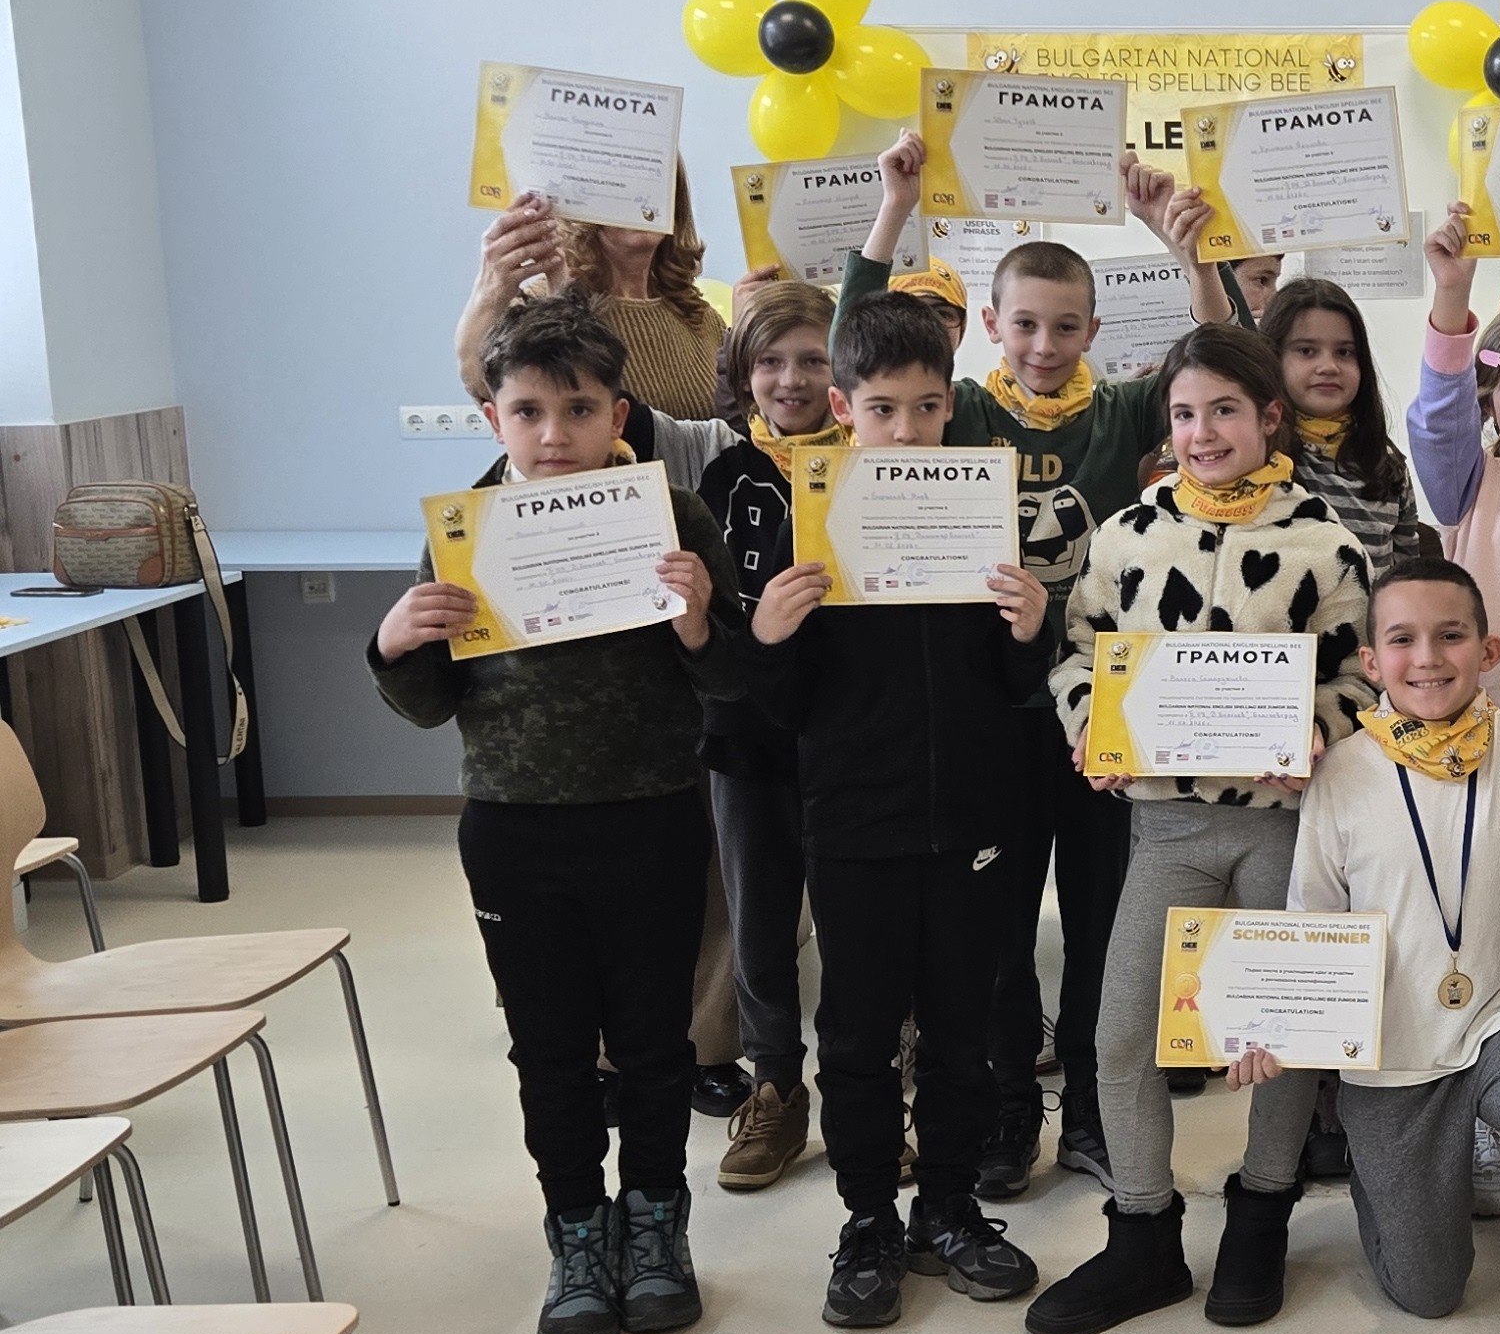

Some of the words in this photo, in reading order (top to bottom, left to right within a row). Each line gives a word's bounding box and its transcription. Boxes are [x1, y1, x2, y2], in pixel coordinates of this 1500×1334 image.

[1037, 48, 1177, 67] BULGARIAN
[1187, 48, 1309, 67] NATIONAL
[1148, 73, 1262, 91] SPELLING
[1271, 73, 1310, 91] BEE
[551, 89, 657, 115] ГРАМОТА
[999, 92, 1104, 111] ГРАМОТА
[1262, 108, 1372, 133] ГРАМОТА
[1145, 121, 1183, 149] LE
[804, 170, 882, 189] ГРАМОТ
[1106, 268, 1182, 286] ГРАМОТ
[876, 467, 990, 481] ГРАМОТА
[516, 486, 641, 518] ГРАМОТА
[1177, 651, 1289, 664] ГРАМОТА
[1397, 729, 1429, 749] 2026
[1233, 929, 1298, 942] SCHOOL
[1305, 931, 1371, 944] WINNER
